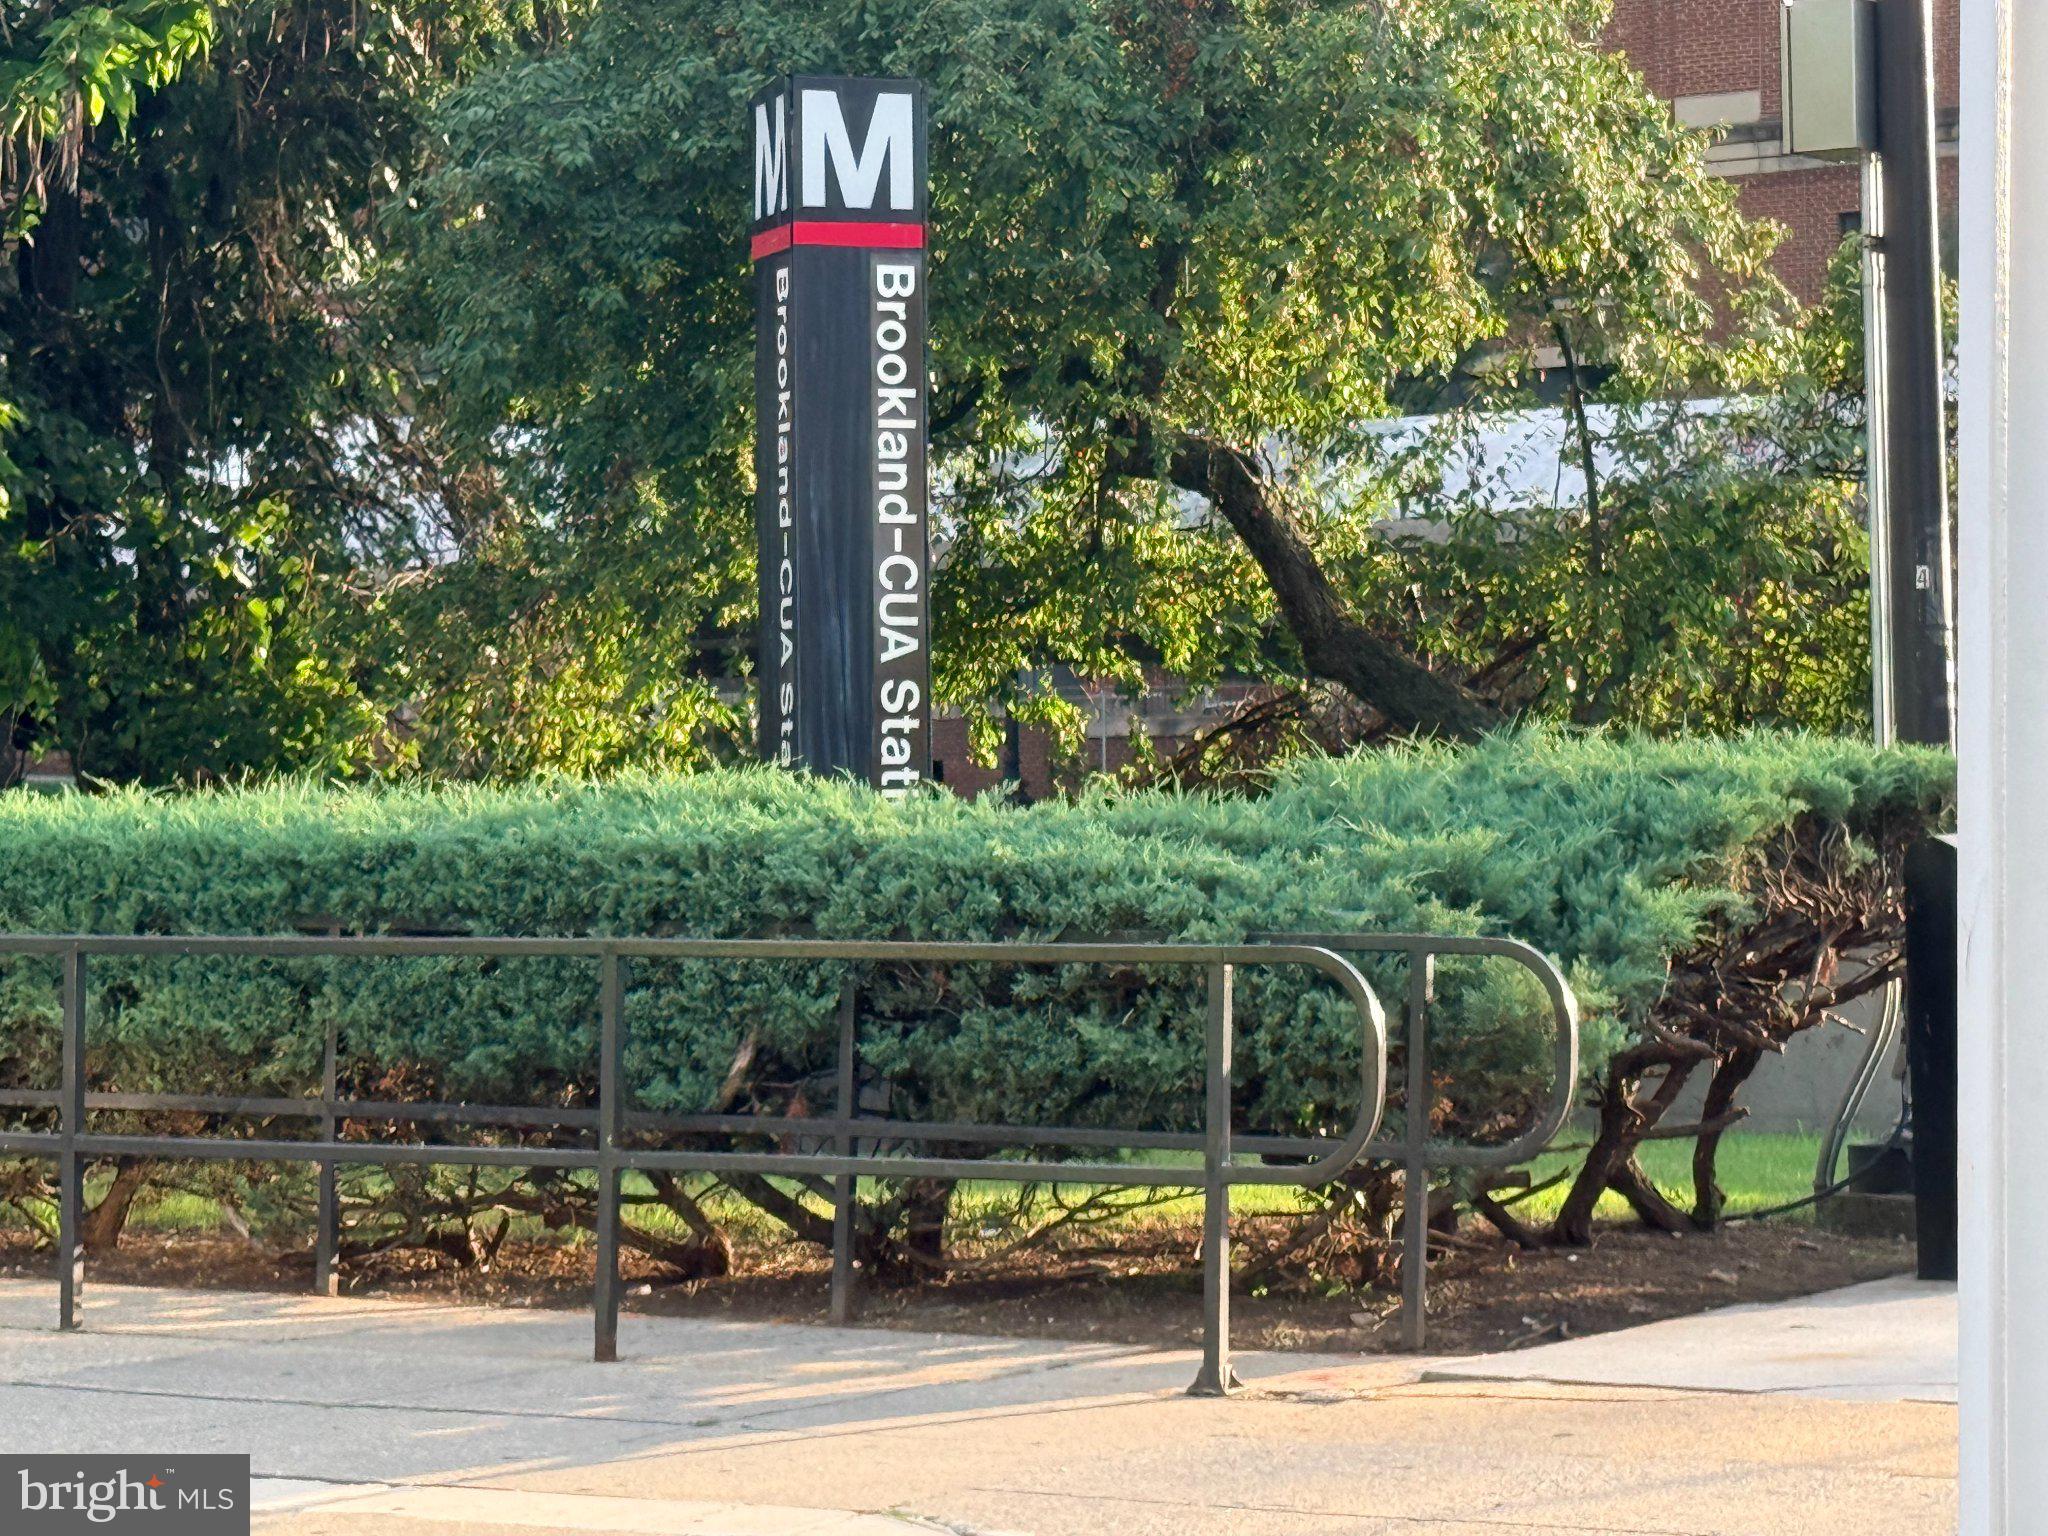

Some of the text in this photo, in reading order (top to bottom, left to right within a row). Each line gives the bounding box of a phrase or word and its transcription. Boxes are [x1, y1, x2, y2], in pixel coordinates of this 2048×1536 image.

[755, 94, 788, 221] M
[802, 89, 914, 210] M
[776, 267, 794, 669] Brookland-CUA
[876, 264, 919, 664] Brookland-CUA
